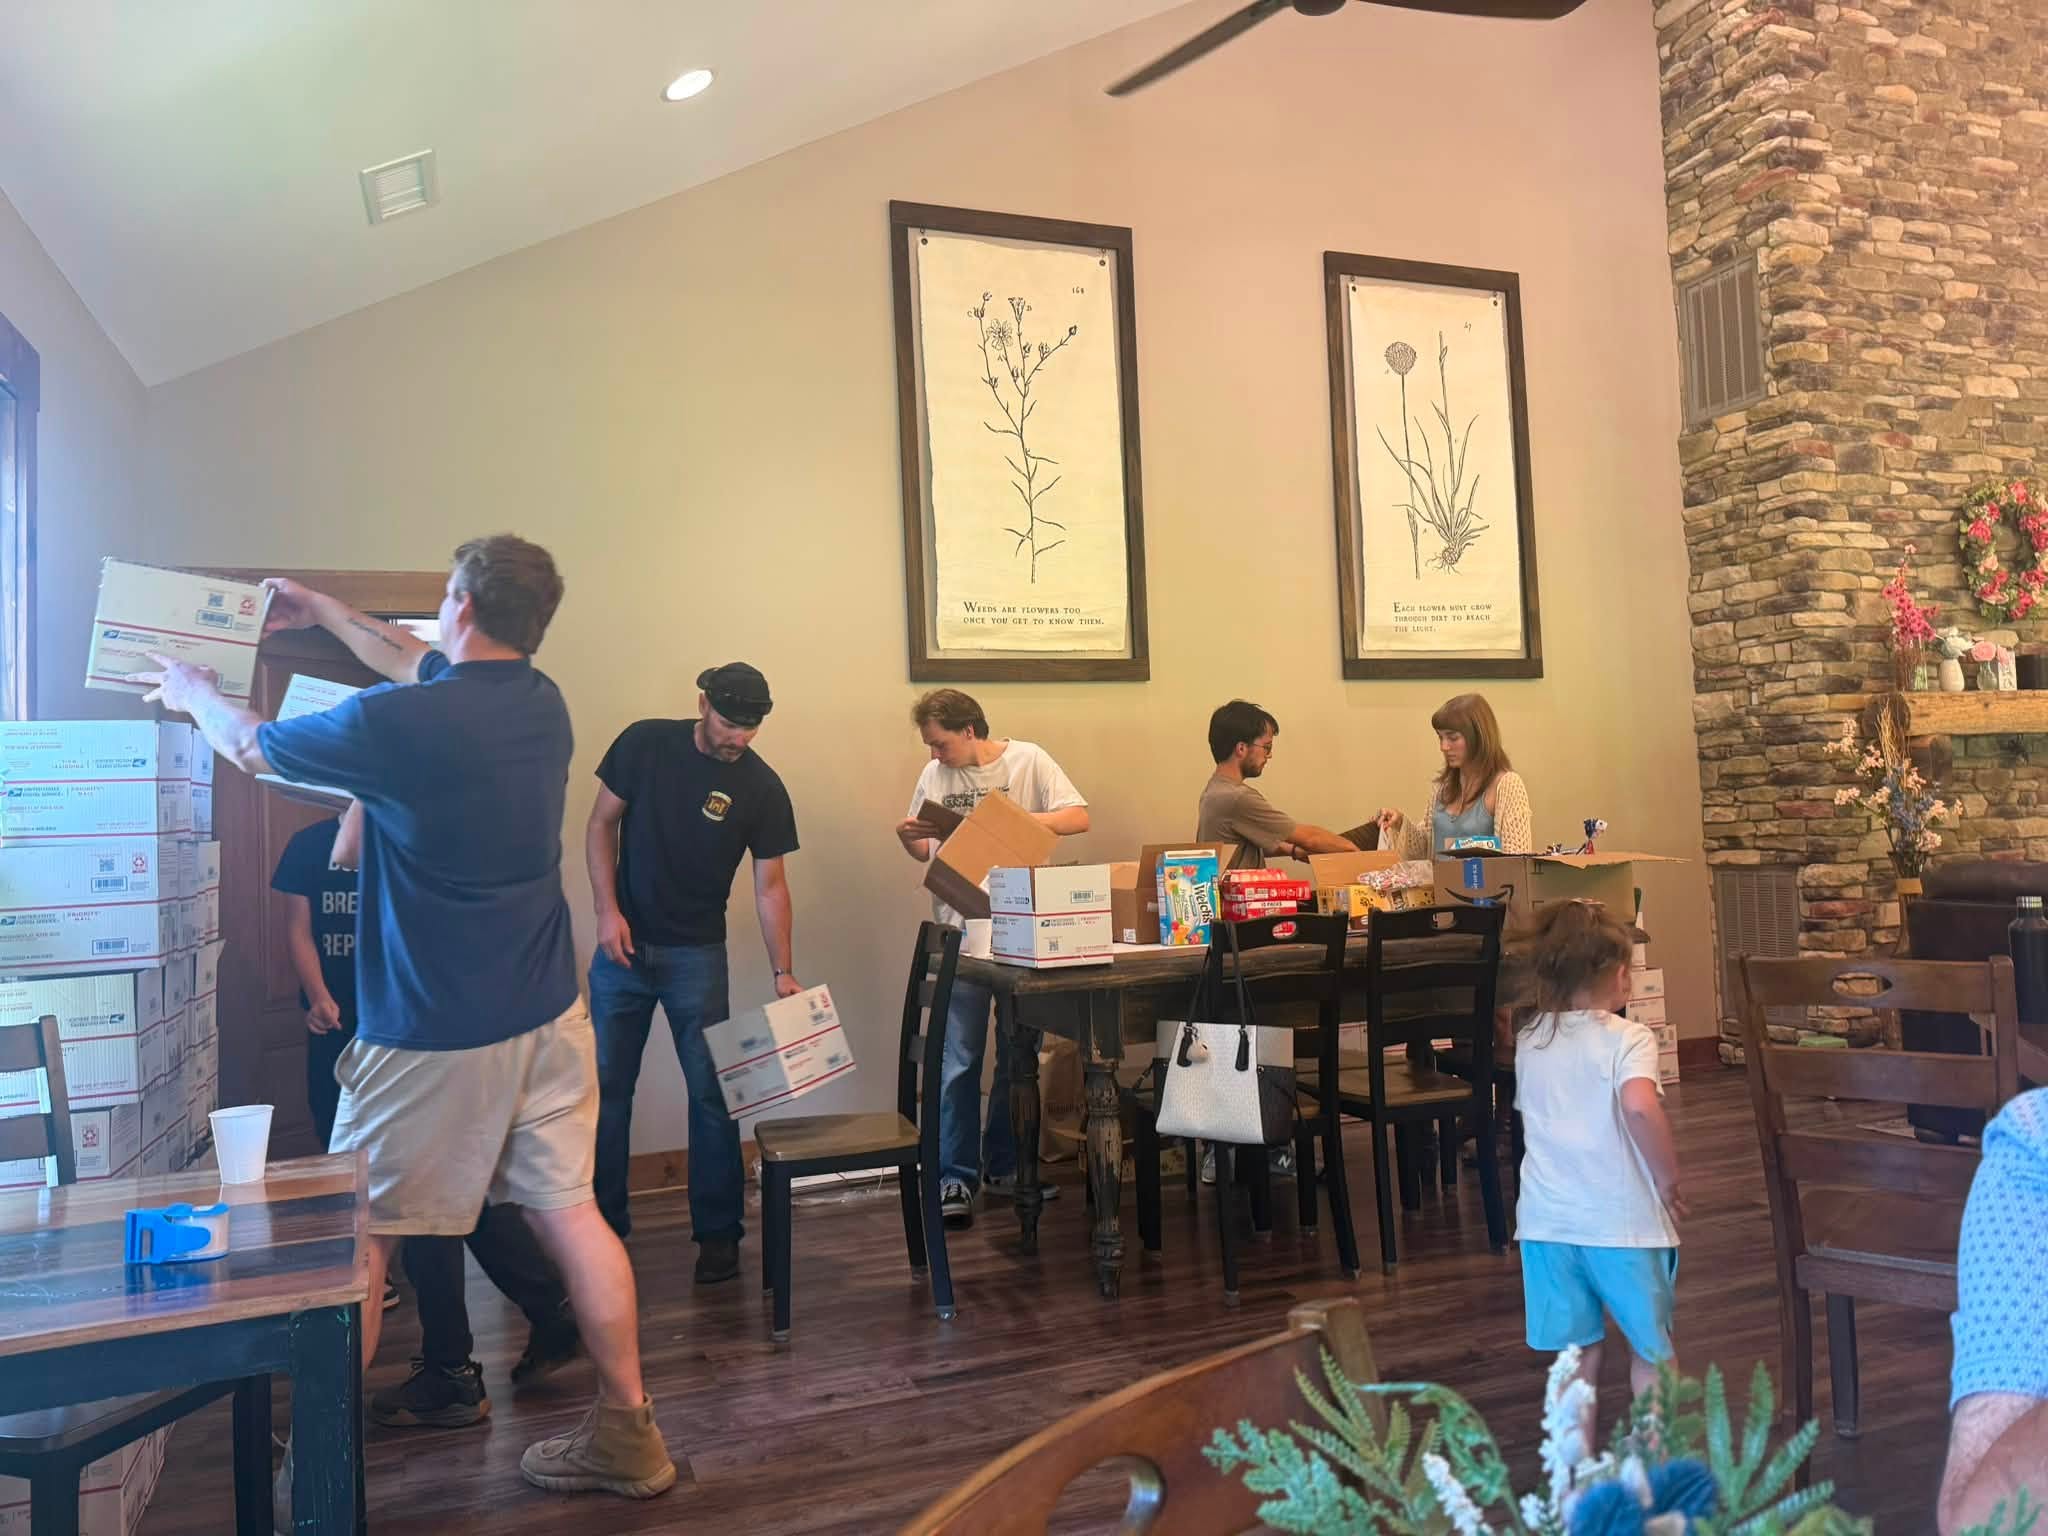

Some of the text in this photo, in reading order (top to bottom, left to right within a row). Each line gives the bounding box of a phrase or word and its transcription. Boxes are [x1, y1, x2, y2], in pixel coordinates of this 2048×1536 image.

[963, 601, 1081, 615] WEEDS ARE FLOWERS TOO
[1393, 601, 1416, 613] EACH
[1449, 604, 1467, 612] MUST
[963, 617, 986, 625] ONCE
[991, 617, 1008, 625] YOU
[1012, 617, 1028, 625] GET
[1079, 617, 1105, 625] THEM.
[1394, 615, 1428, 623] THROUGH
[1394, 625, 1408, 633] THE
[1194, 884, 1213, 923] Welch's
